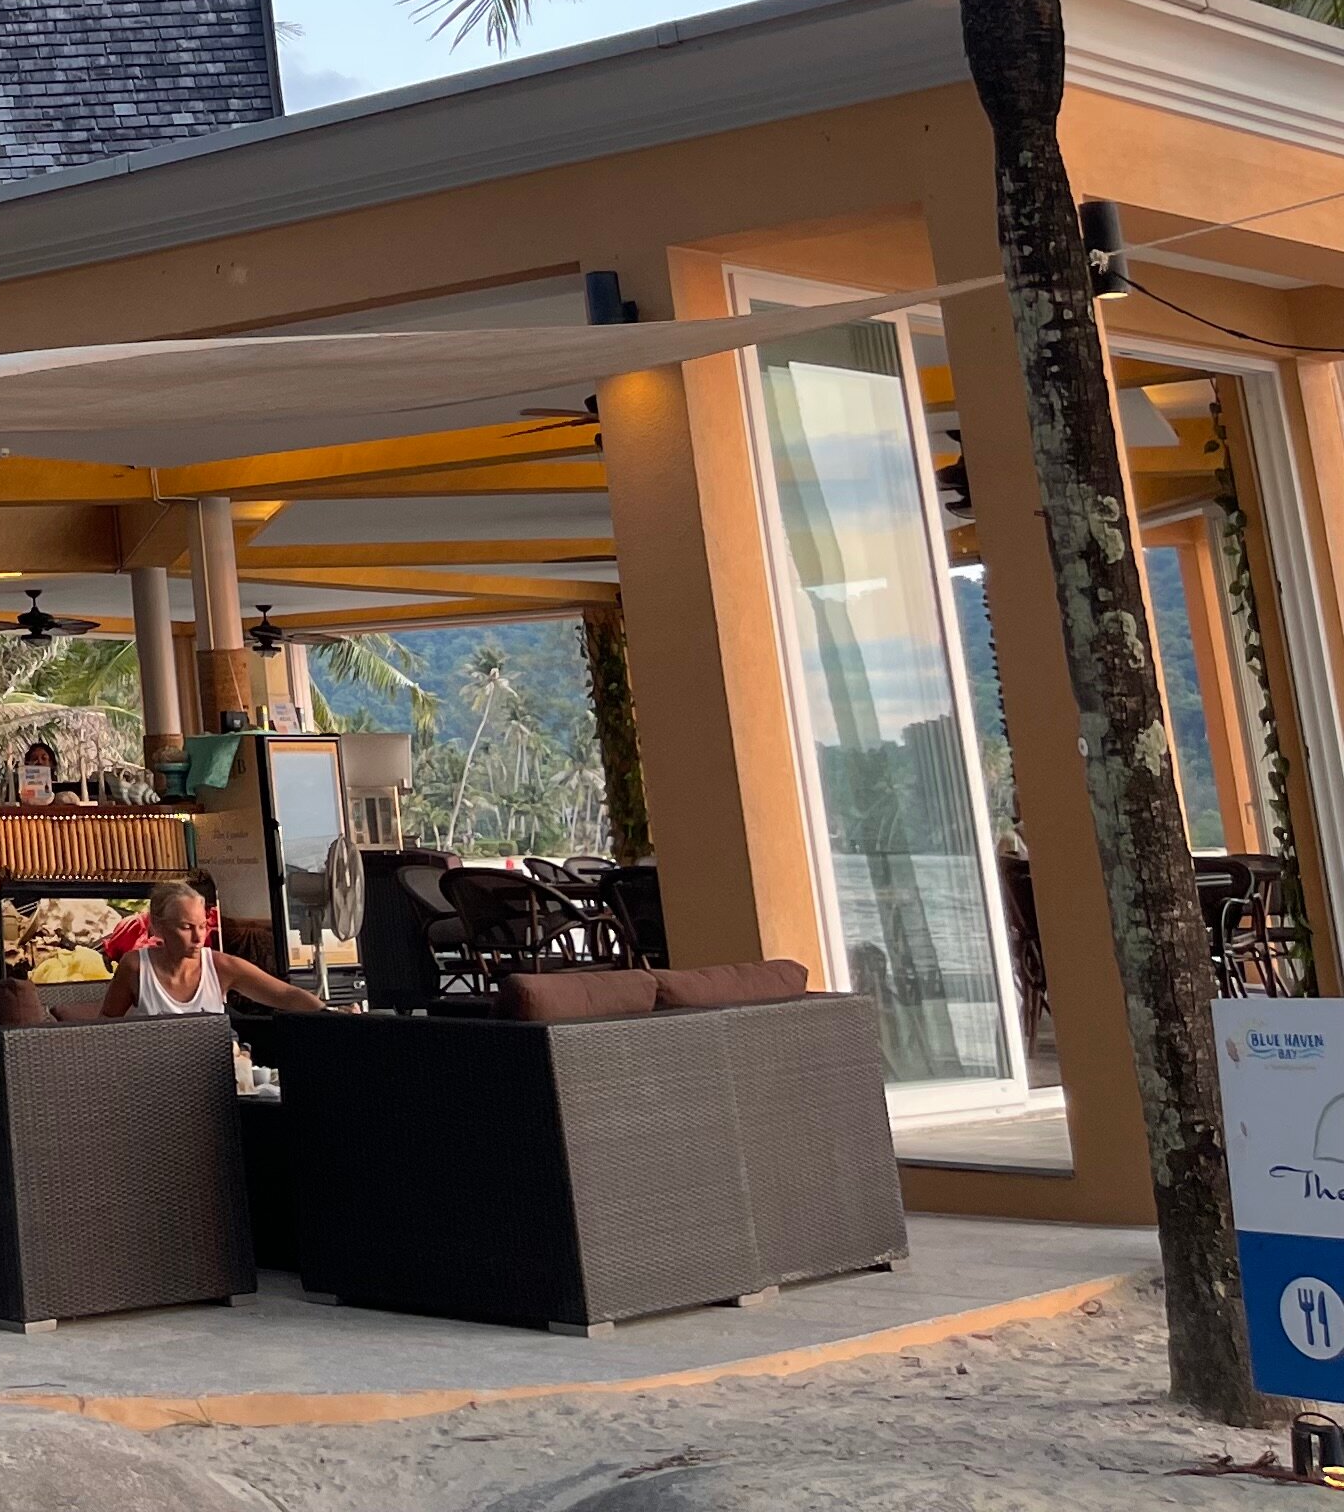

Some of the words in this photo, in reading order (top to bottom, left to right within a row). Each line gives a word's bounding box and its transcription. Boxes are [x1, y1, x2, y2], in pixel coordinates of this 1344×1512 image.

[1250, 1033, 1281, 1047] BLUE
[1284, 1033, 1324, 1047] HAVEN
[1278, 1048, 1297, 1060] BAY
